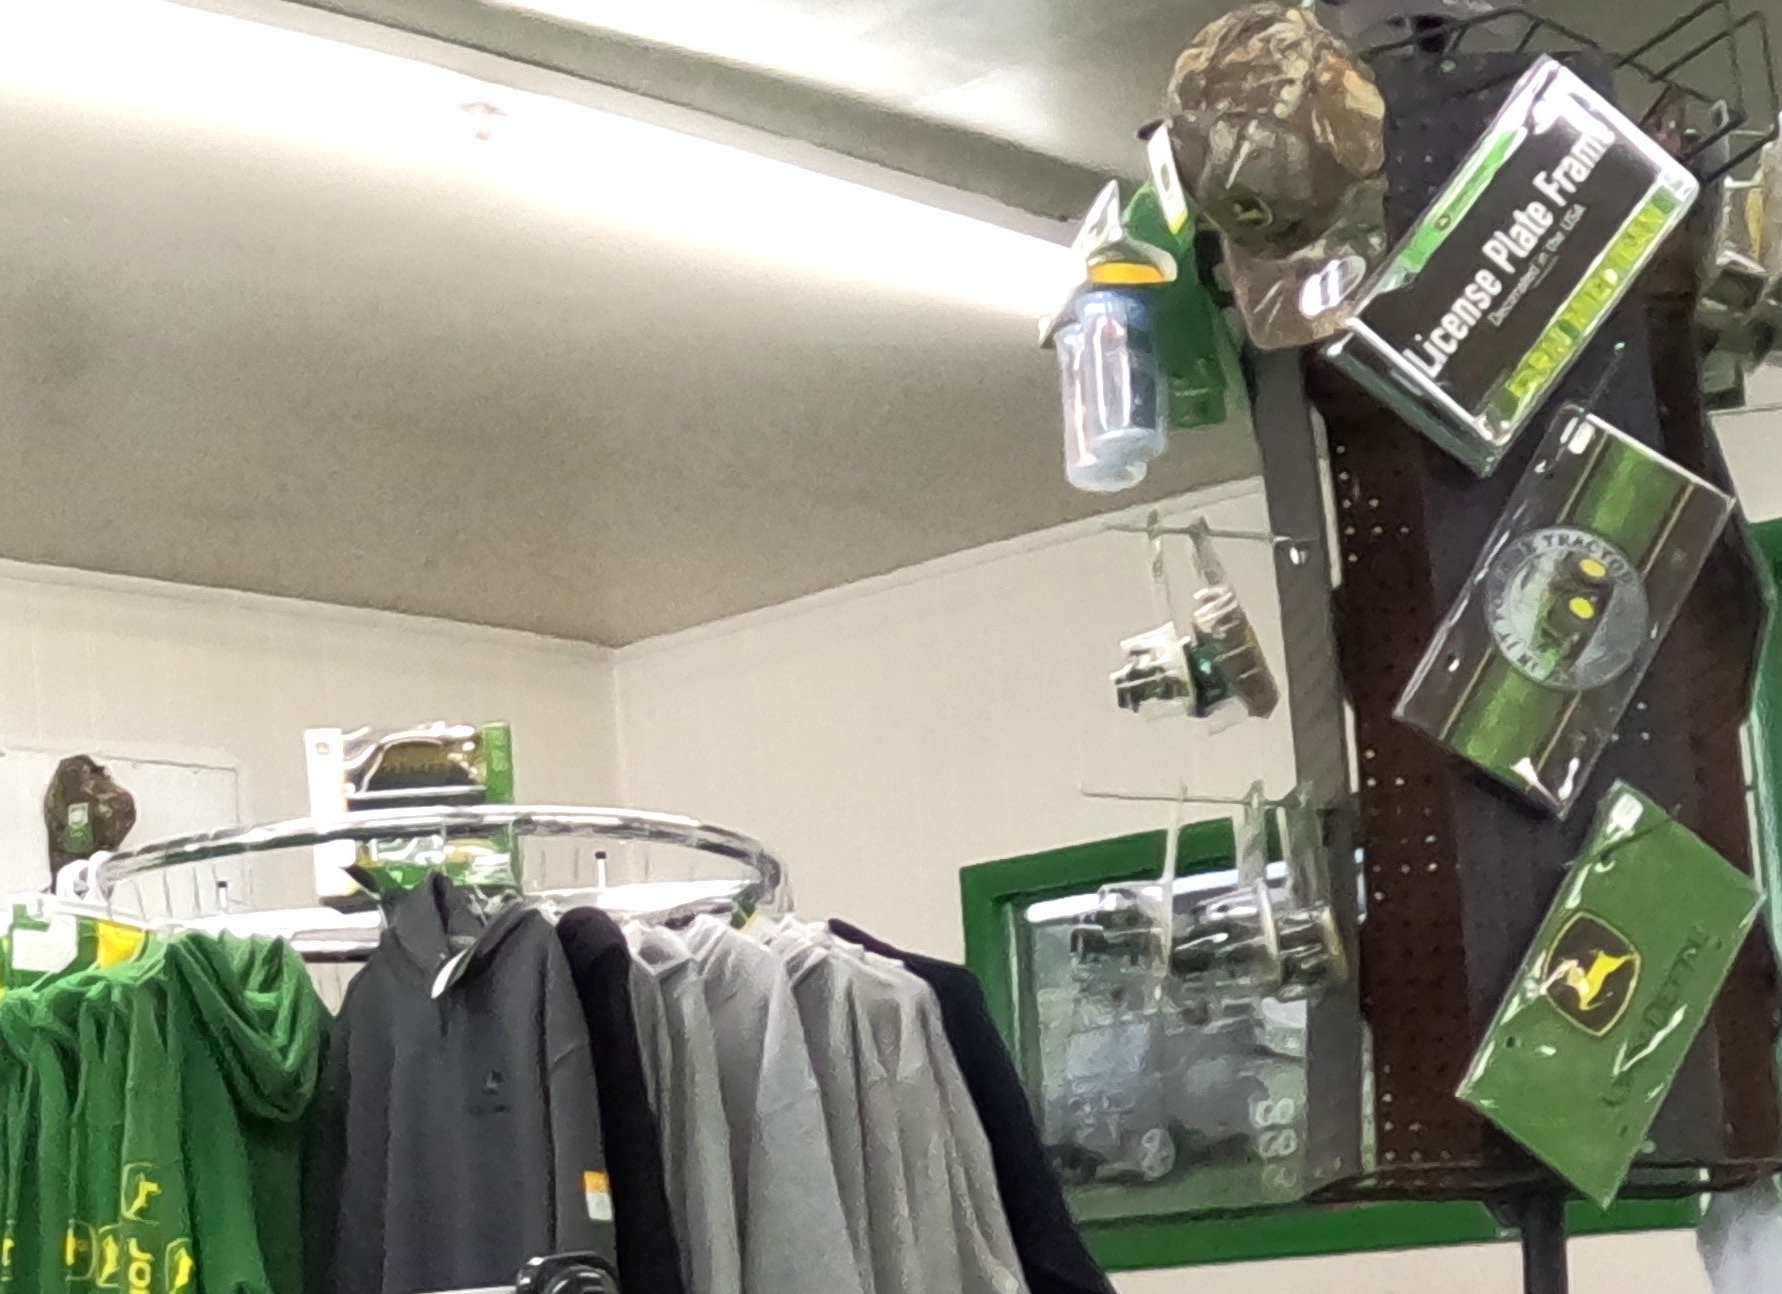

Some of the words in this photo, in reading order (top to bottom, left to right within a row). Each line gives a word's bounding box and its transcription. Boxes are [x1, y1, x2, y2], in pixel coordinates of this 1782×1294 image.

[1562, 203, 1588, 231] USA
[1403, 269, 1502, 378] License
[1482, 201, 1553, 274] Plate
